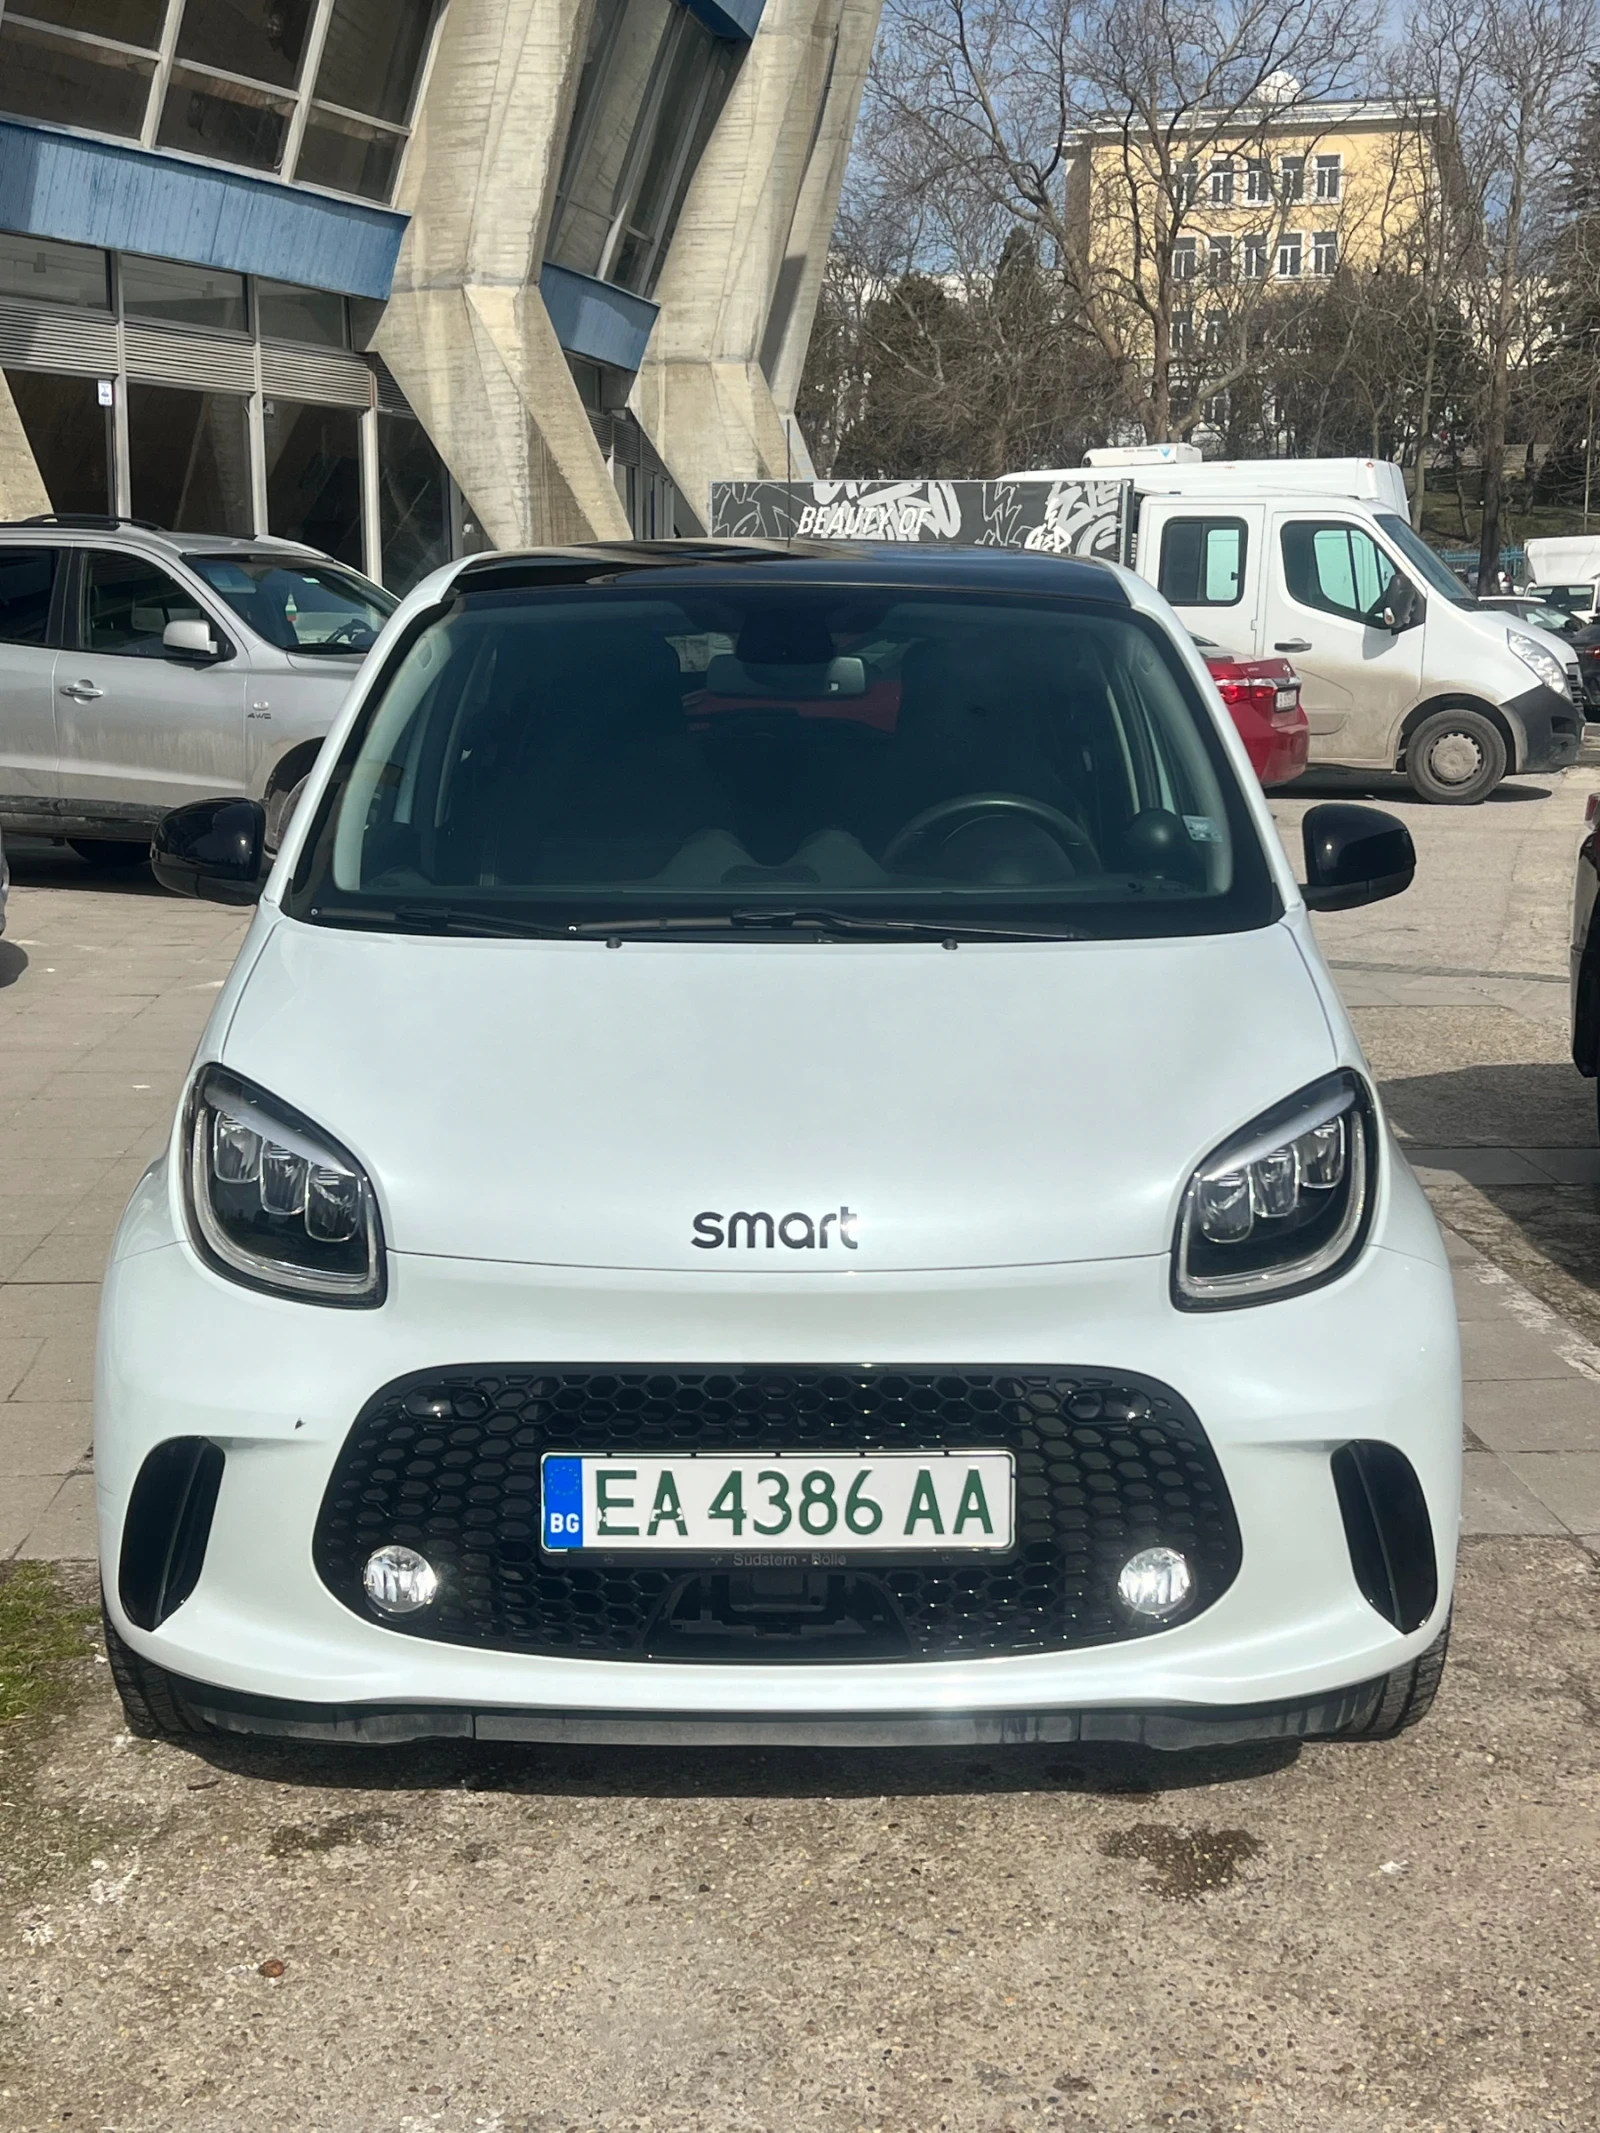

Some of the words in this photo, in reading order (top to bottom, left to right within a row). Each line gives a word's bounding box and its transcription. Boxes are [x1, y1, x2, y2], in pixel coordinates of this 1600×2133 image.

[796, 506, 892, 535] BEAUTY
[899, 507, 932, 535] OF
[690, 1206, 858, 1250] smart
[596, 1469, 688, 1536] EA
[708, 1469, 882, 1536] 4386
[903, 1468, 995, 1535] AA
[550, 1512, 580, 1533] BG
